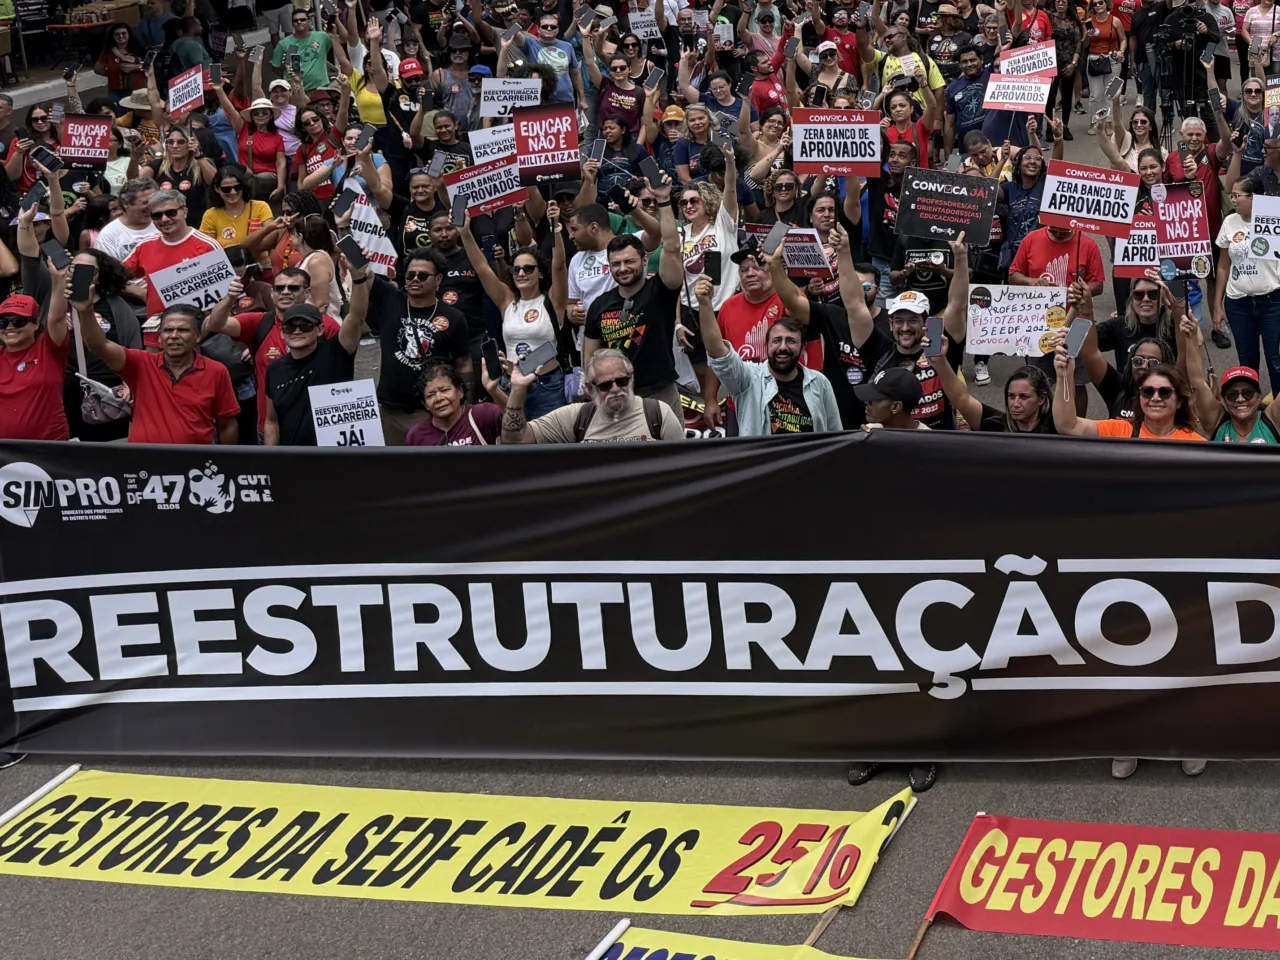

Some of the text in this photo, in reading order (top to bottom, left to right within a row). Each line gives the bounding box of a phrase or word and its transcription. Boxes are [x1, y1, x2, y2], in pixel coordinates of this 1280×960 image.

[1006, 57, 1053, 75] APROVADOS
[1008, 59, 1020, 67] ZERA
[1022, 53, 1040, 63] BANCO
[172, 84, 201, 108] APROVADOS
[990, 91, 1044, 102] APROVADOS
[851, 114, 864, 122] JÁ!
[68, 123, 108, 136] EDUCAR
[520, 116, 571, 137] EDUCAR
[804, 129, 869, 139] ZERA BANCO DE
[71, 136, 91, 147] NÃO
[528, 132, 567, 152] NÃO É
[800, 141, 875, 158] APROVADOS
[61, 148, 108, 157] MILITARIZAR
[519, 150, 579, 166] MILITARIZAR
[456, 168, 514, 194] ZERA BANCO DE
[1108, 173, 1124, 183] JÁ!
[969, 188, 988, 198] JÁ!
[1056, 181, 1126, 200] ZERA BANCO DE
[917, 197, 979, 210] PROFESSORES(AS)
[1048, 193, 1129, 219] APROVADOS
[1158, 200, 1202, 220] EDUCAR
[917, 205, 981, 219] ORIENTADORES(AS)
[920, 213, 970, 224] EDUCACIONAIS
[1165, 217, 1200, 239] NÃO É
[1254, 225, 1276, 234] DA
[1159, 242, 1211, 255] MILITARIZAR
[787, 253, 825, 265] APROVADOS
[160, 264, 228, 295] REESTRUTURAÇÃO
[163, 270, 234, 302] DA CARREIRA
[994, 287, 1046, 302] Nomeia
[988, 303, 1050, 315] PROFESSOR
[972, 315, 1045, 327] FISIOTERAPIA
[980, 326, 1020, 337] SEEDF
[970, 337, 1009, 345] CONVOCA
[314, 399, 376, 415] REESTRUTURAÇÃO
[316, 409, 378, 427] DA CARREIRA
[336, 425, 365, 447] JÁ!
[2, 476, 121, 510] SINPRO
[140, 475, 186, 504] 47
[4, 553, 1178, 702] REESTRUTURAÇÃO
[3, 794, 280, 880] GESTORES
[238, 812, 348, 884] DA
[324, 812, 469, 890] SEDF
[452, 810, 618, 896] CADÊ
[598, 827, 699, 903] OS
[959, 827, 1222, 928] GESTORES
